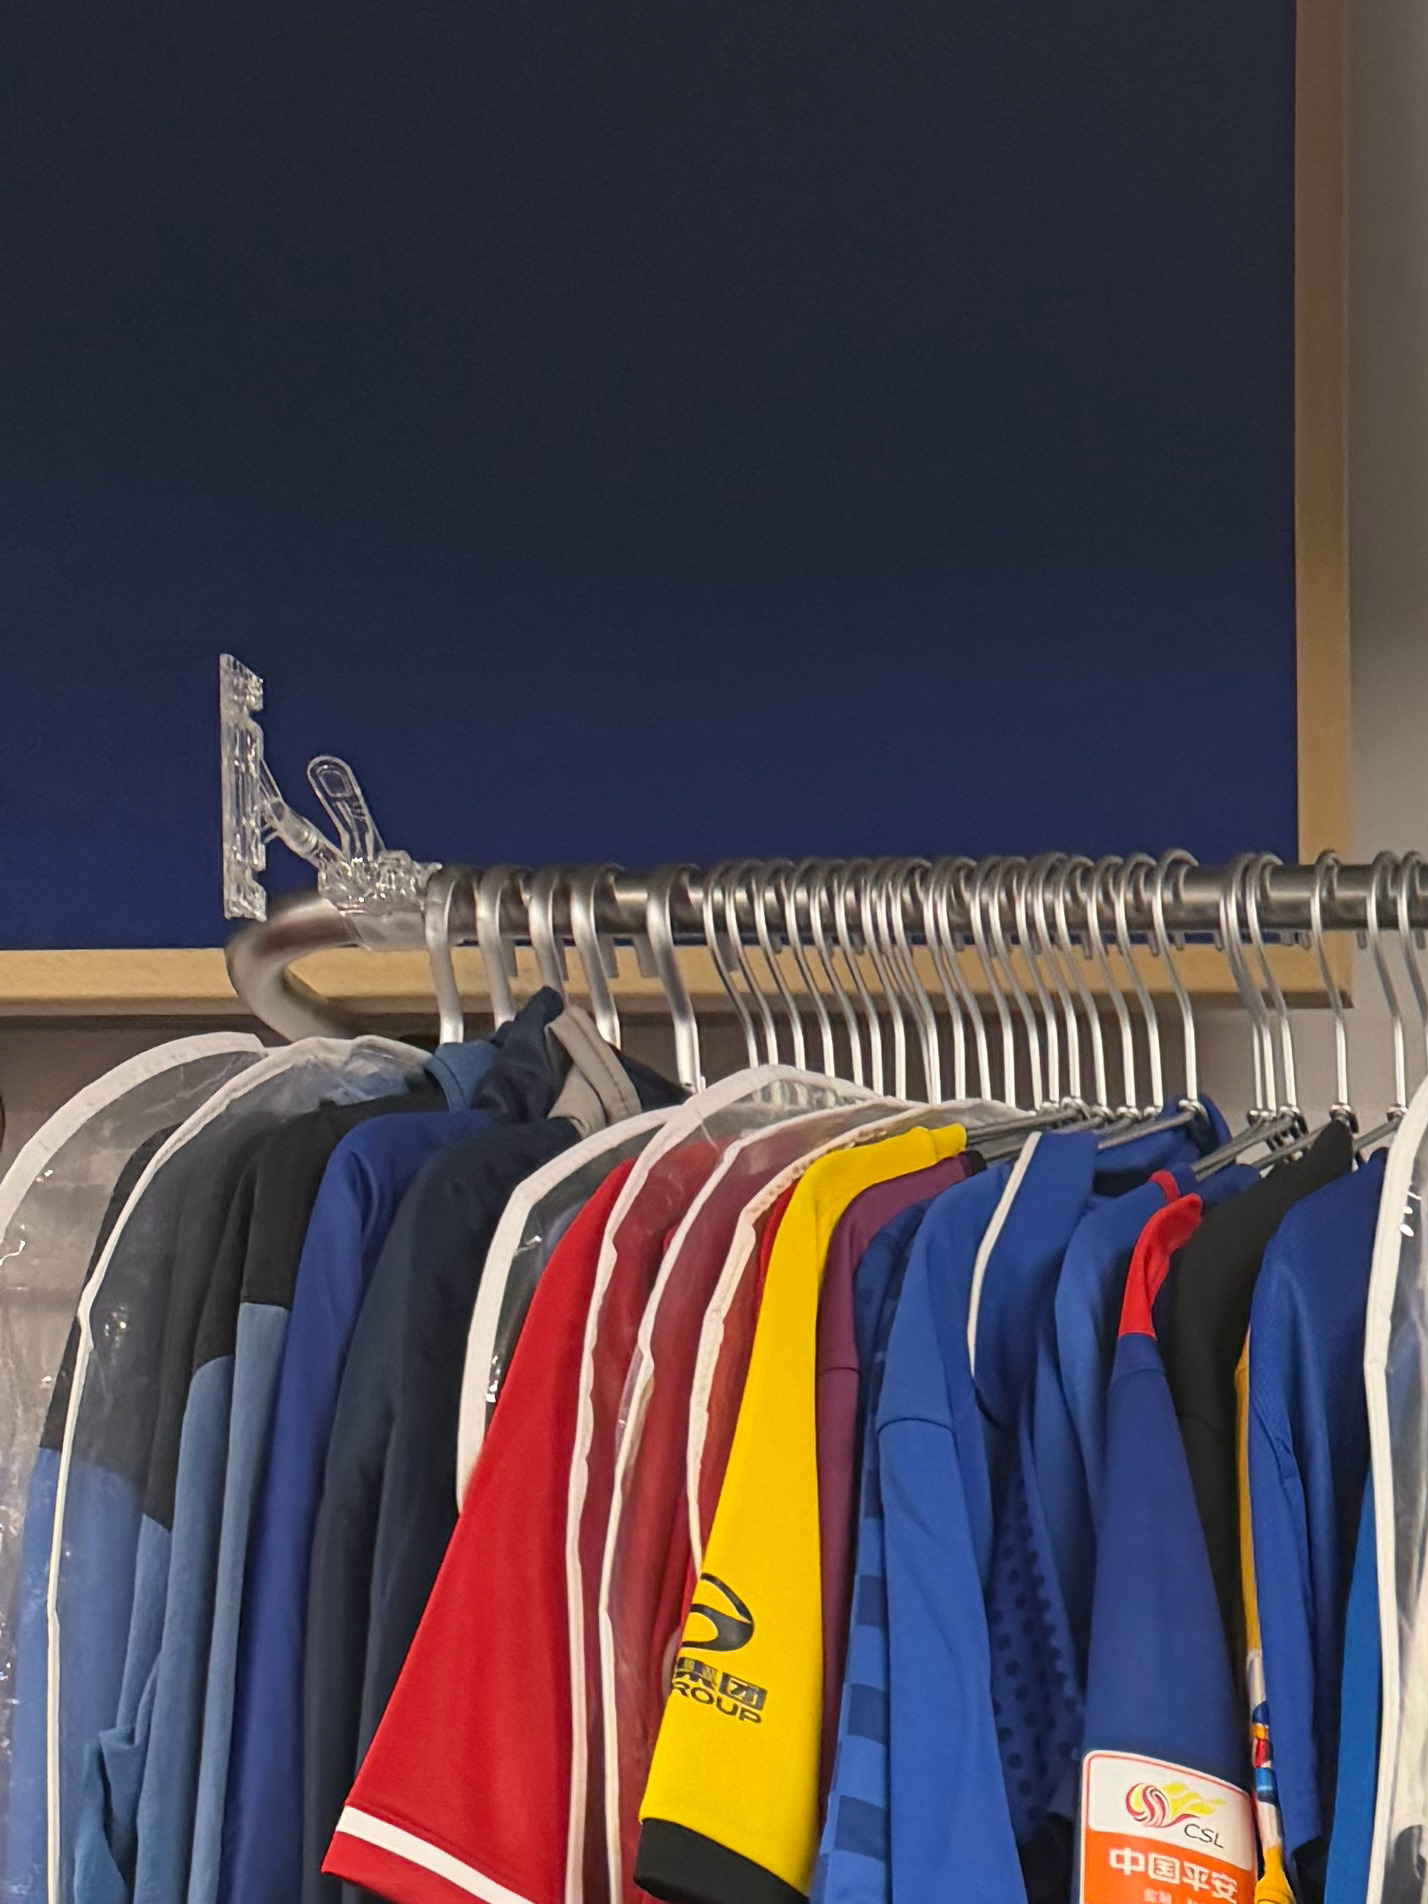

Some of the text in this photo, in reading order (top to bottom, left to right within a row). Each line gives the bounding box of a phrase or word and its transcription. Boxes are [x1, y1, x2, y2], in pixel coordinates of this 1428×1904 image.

[1183, 1823, 1225, 1849] CSL
[1109, 1846, 1238, 1904] 中国平安
